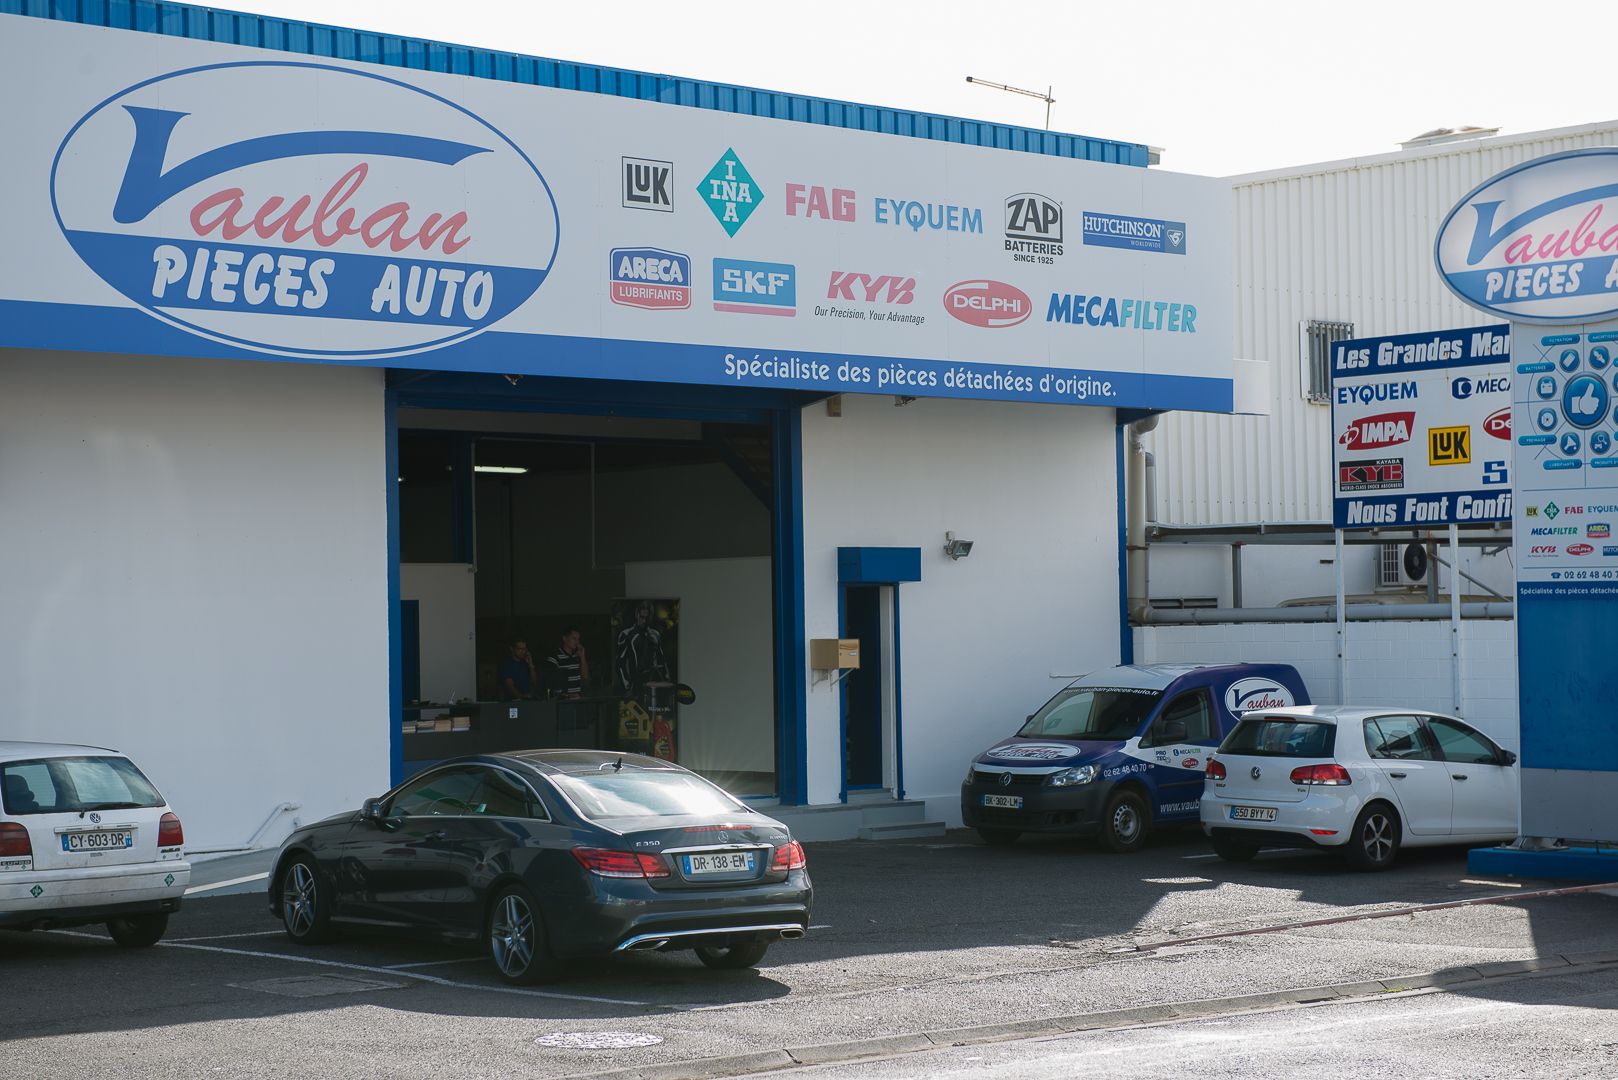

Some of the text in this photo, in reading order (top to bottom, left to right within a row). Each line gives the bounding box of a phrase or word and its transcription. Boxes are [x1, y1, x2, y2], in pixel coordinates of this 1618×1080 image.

[113, 105, 494, 254] Vauban
[626, 163, 670, 206] LUK
[786, 183, 856, 222] FAG
[874, 197, 983, 234] EYQUEM
[1007, 198, 1059, 234] ZAP
[1005, 240, 1064, 256] BATTERIES
[1013, 254, 1054, 265] SINCE 1925
[152, 245, 494, 320] PIECES AUTO
[618, 256, 684, 283] ARECA
[721, 268, 790, 296] SKF
[1486, 262, 1584, 301] PIECES
[619, 286, 683, 302] LUBRIFIANTS
[827, 271, 916, 305] KYB
[814, 305, 925, 326] Our Precision, Your Advantage
[954, 294, 1021, 314] DELPHI
[1046, 293, 1197, 333] MECAFILTER
[1336, 346, 1370, 370] Les
[1377, 337, 1463, 367] Grandes
[724, 353, 1117, 400] Spécialiste des pièces détachées d'origine.
[1338, 381, 1418, 406] EYQUEM
[1361, 420, 1411, 444] IMPA
[1433, 431, 1468, 460] LUK
[1341, 464, 1403, 482] KYB
[1347, 501, 1397, 525] Nous
[1405, 496, 1449, 522] Font
[1564, 506, 1584, 514] FAG
[1531, 527, 1578, 536] MECAFILTER
[1564, 571, 1575, 579] 02
[1576, 571, 1587, 579] 62
[1589, 571, 1600, 579] 48
[1520, 587, 1553, 595] Spécialiste
[1568, 586, 1588, 595] pièces
[1232, 688, 1286, 709] Vauban
[1104, 769, 1112, 777] 02
[1113, 767, 1120, 775] 62
[1122, 765, 1130, 774] 48
[1131, 764, 1139, 772] 40
[1140, 763, 1147, 772] 70
